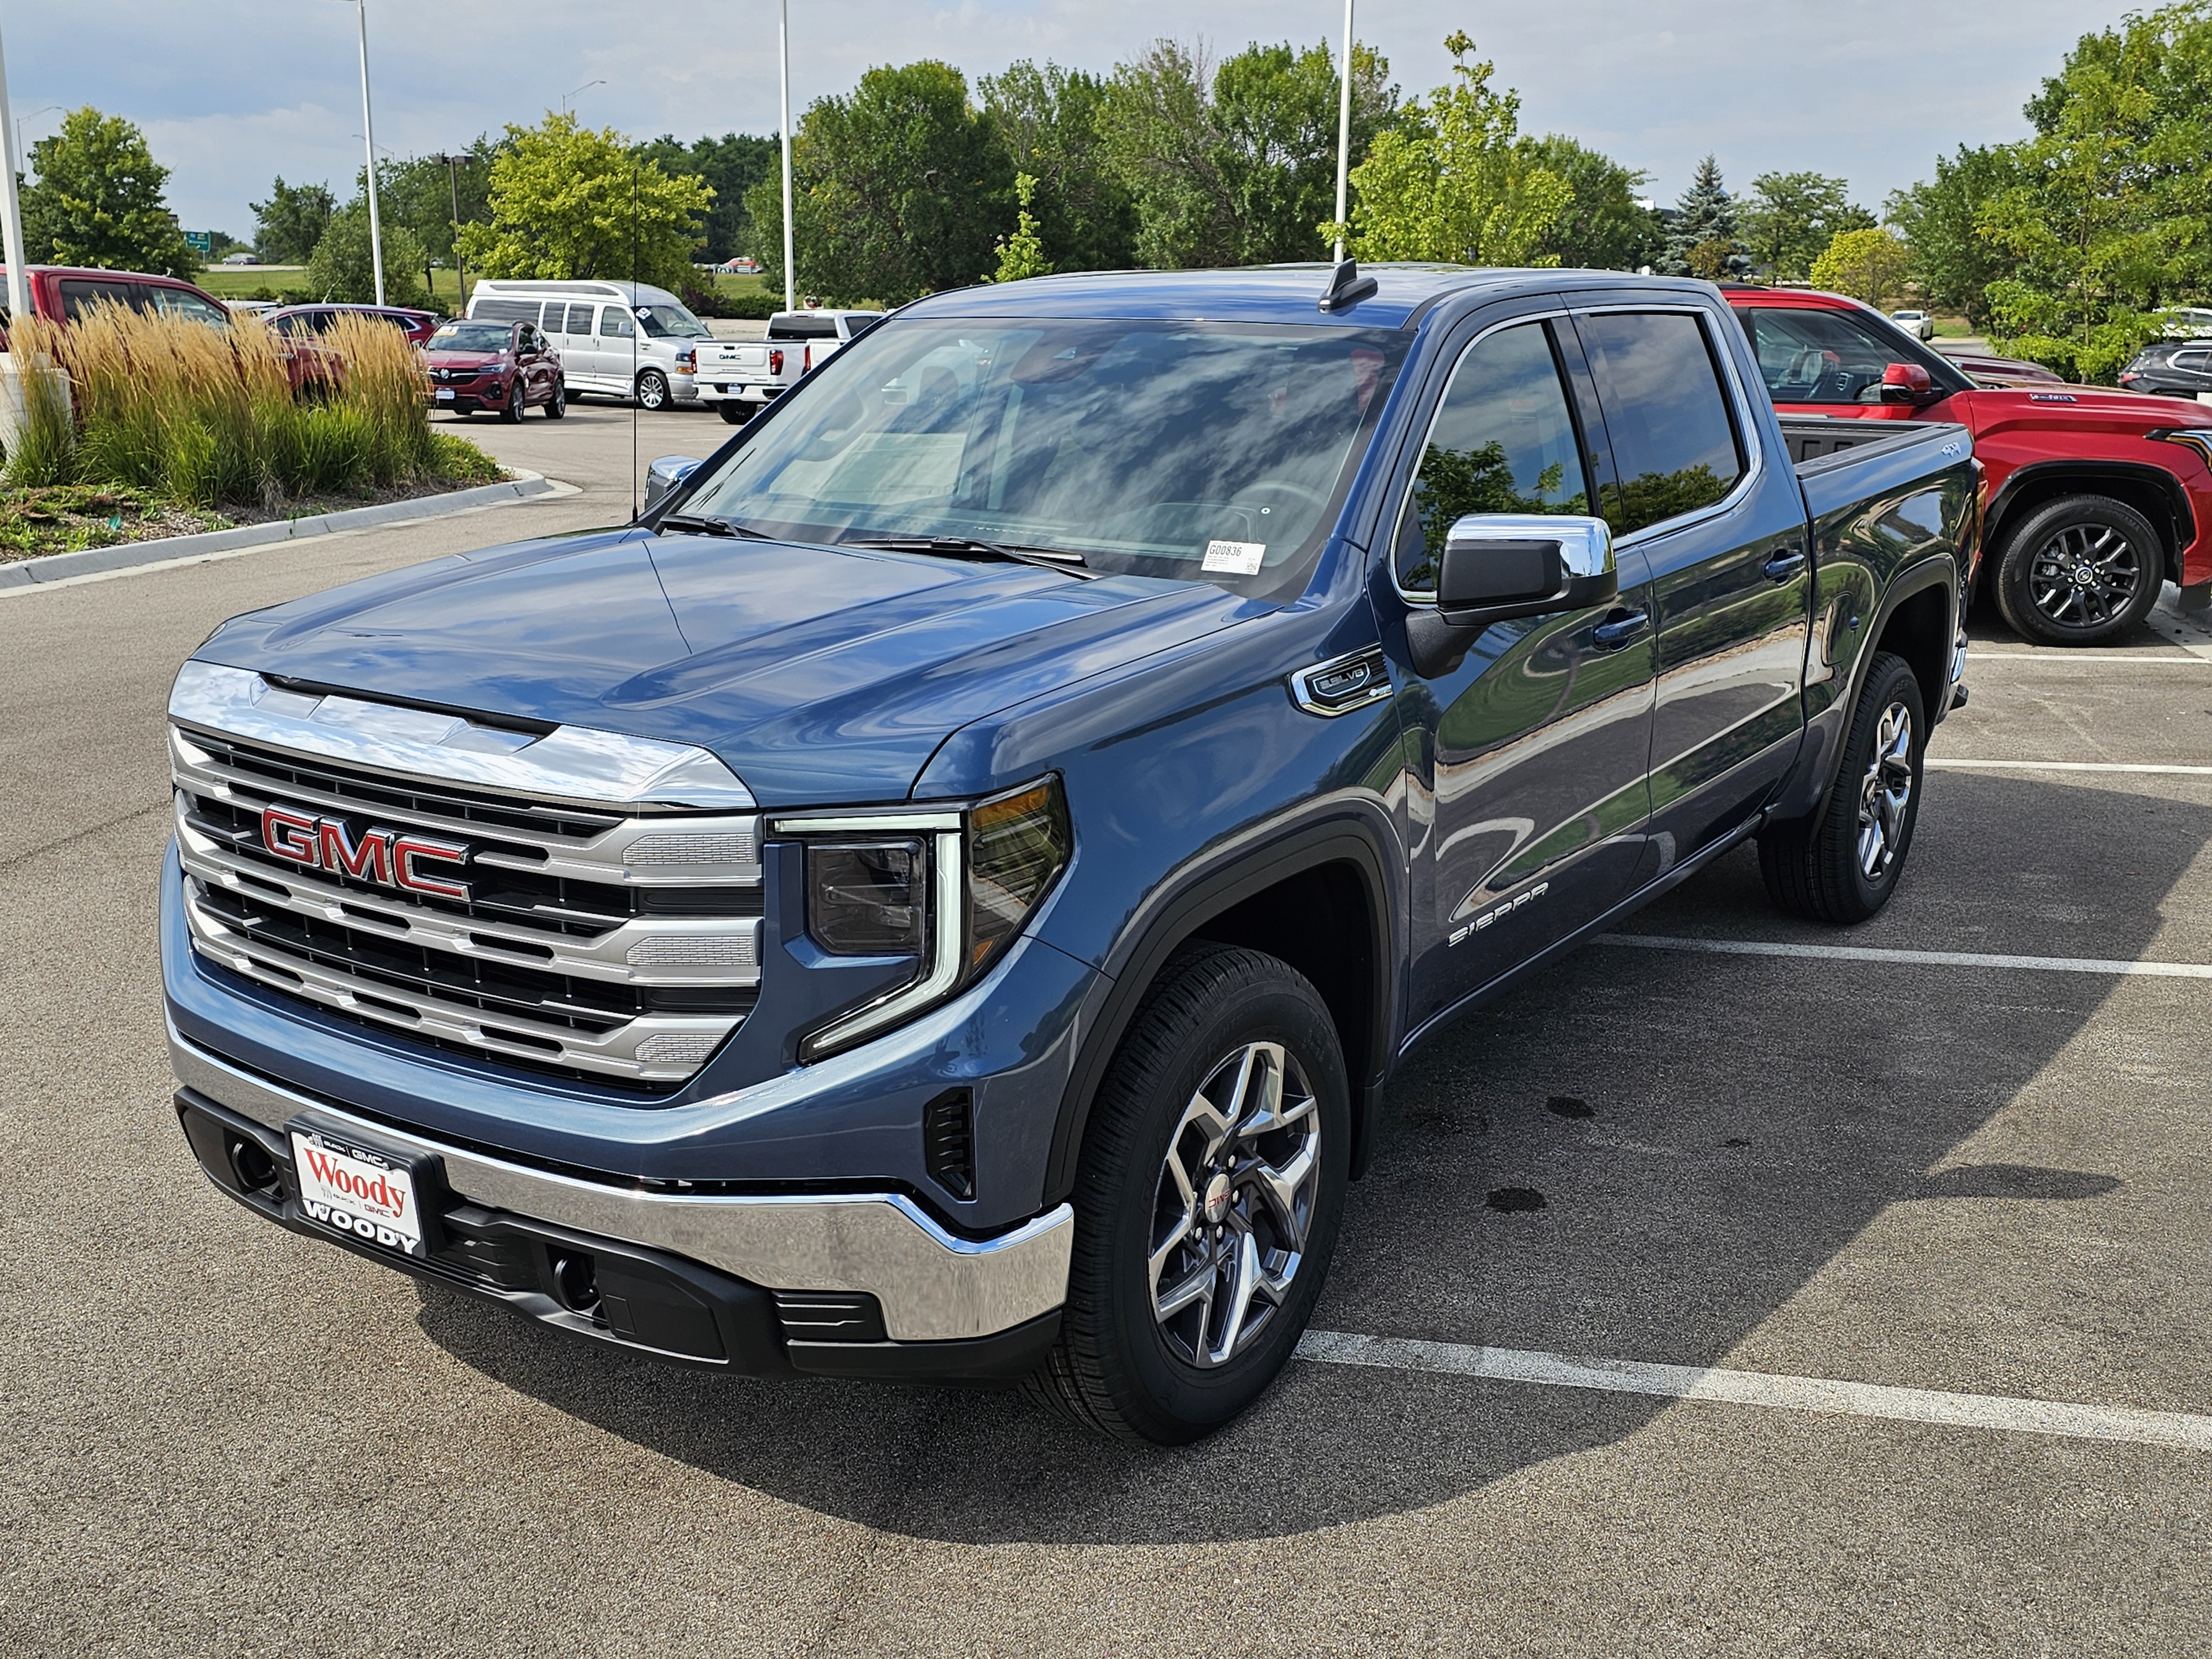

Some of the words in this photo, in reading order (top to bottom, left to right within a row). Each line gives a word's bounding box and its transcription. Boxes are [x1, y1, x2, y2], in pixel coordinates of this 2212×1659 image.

[1209, 545, 1243, 556] G00836
[262, 802, 471, 902] GMC
[1447, 881, 1549, 947] SIERRA
[304, 1147, 406, 1218] Woody
[352, 1149, 383, 1167] GMC
[302, 1199, 419, 1255] WOODY
[364, 1204, 390, 1218] GMC
